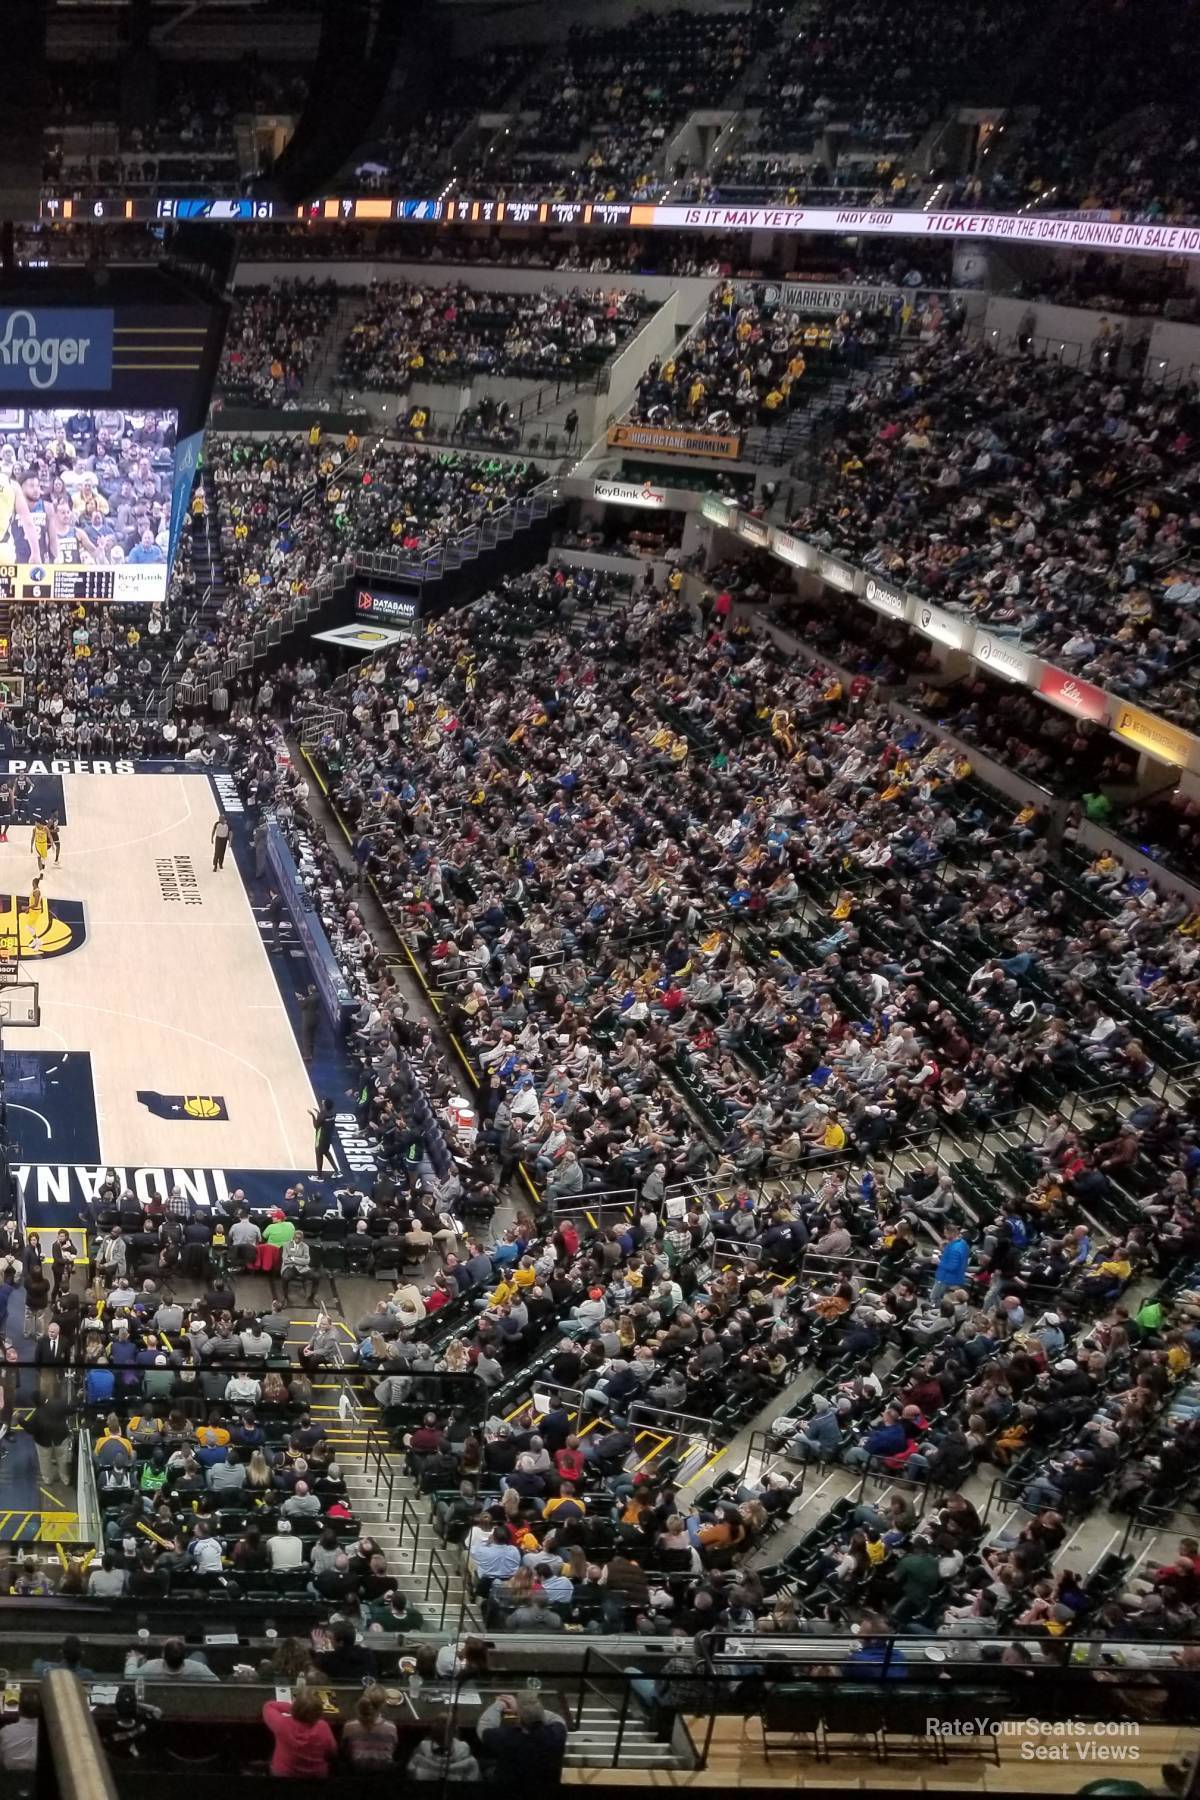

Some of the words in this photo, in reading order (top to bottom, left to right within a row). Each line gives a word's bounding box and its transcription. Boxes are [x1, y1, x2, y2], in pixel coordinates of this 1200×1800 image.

[94, 202, 103, 217] 6
[685, 210, 701, 223] IS
[704, 210, 721, 224] IT
[723, 210, 760, 225] MAY
[762, 211, 804, 226] YET?
[836, 212, 867, 224] INDY
[867, 213, 894, 225] 500
[925, 216, 994, 232] TICKETS
[994, 219, 1016, 234] FOR
[1016, 220, 1036, 236] THE
[1037, 221, 1071, 239] 104TH
[1070, 224, 1123, 244] RUNNING
[1124, 229, 1142, 245] ON
[1143, 231, 1176, 248] SALE
[785, 289, 842, 308] WARREN'S
[652, 433, 686, 447] OCTANE
[686, 438, 731, 452] DRUMLINE
[594, 484, 639, 499] KeyBank
[32, 586, 41, 597] 6
[874, 586, 903, 609] motorola
[373, 598, 415, 612] DATABANK
[1059, 680, 1083, 707] Lilly
[8, 759, 136, 775] PACERS
[154, 858, 181, 901] FIELDHOUSE
[173, 855, 198, 887] BANKERS
[181, 890, 203, 905] LIFE
[334, 1113, 378, 1172] @PACERS
